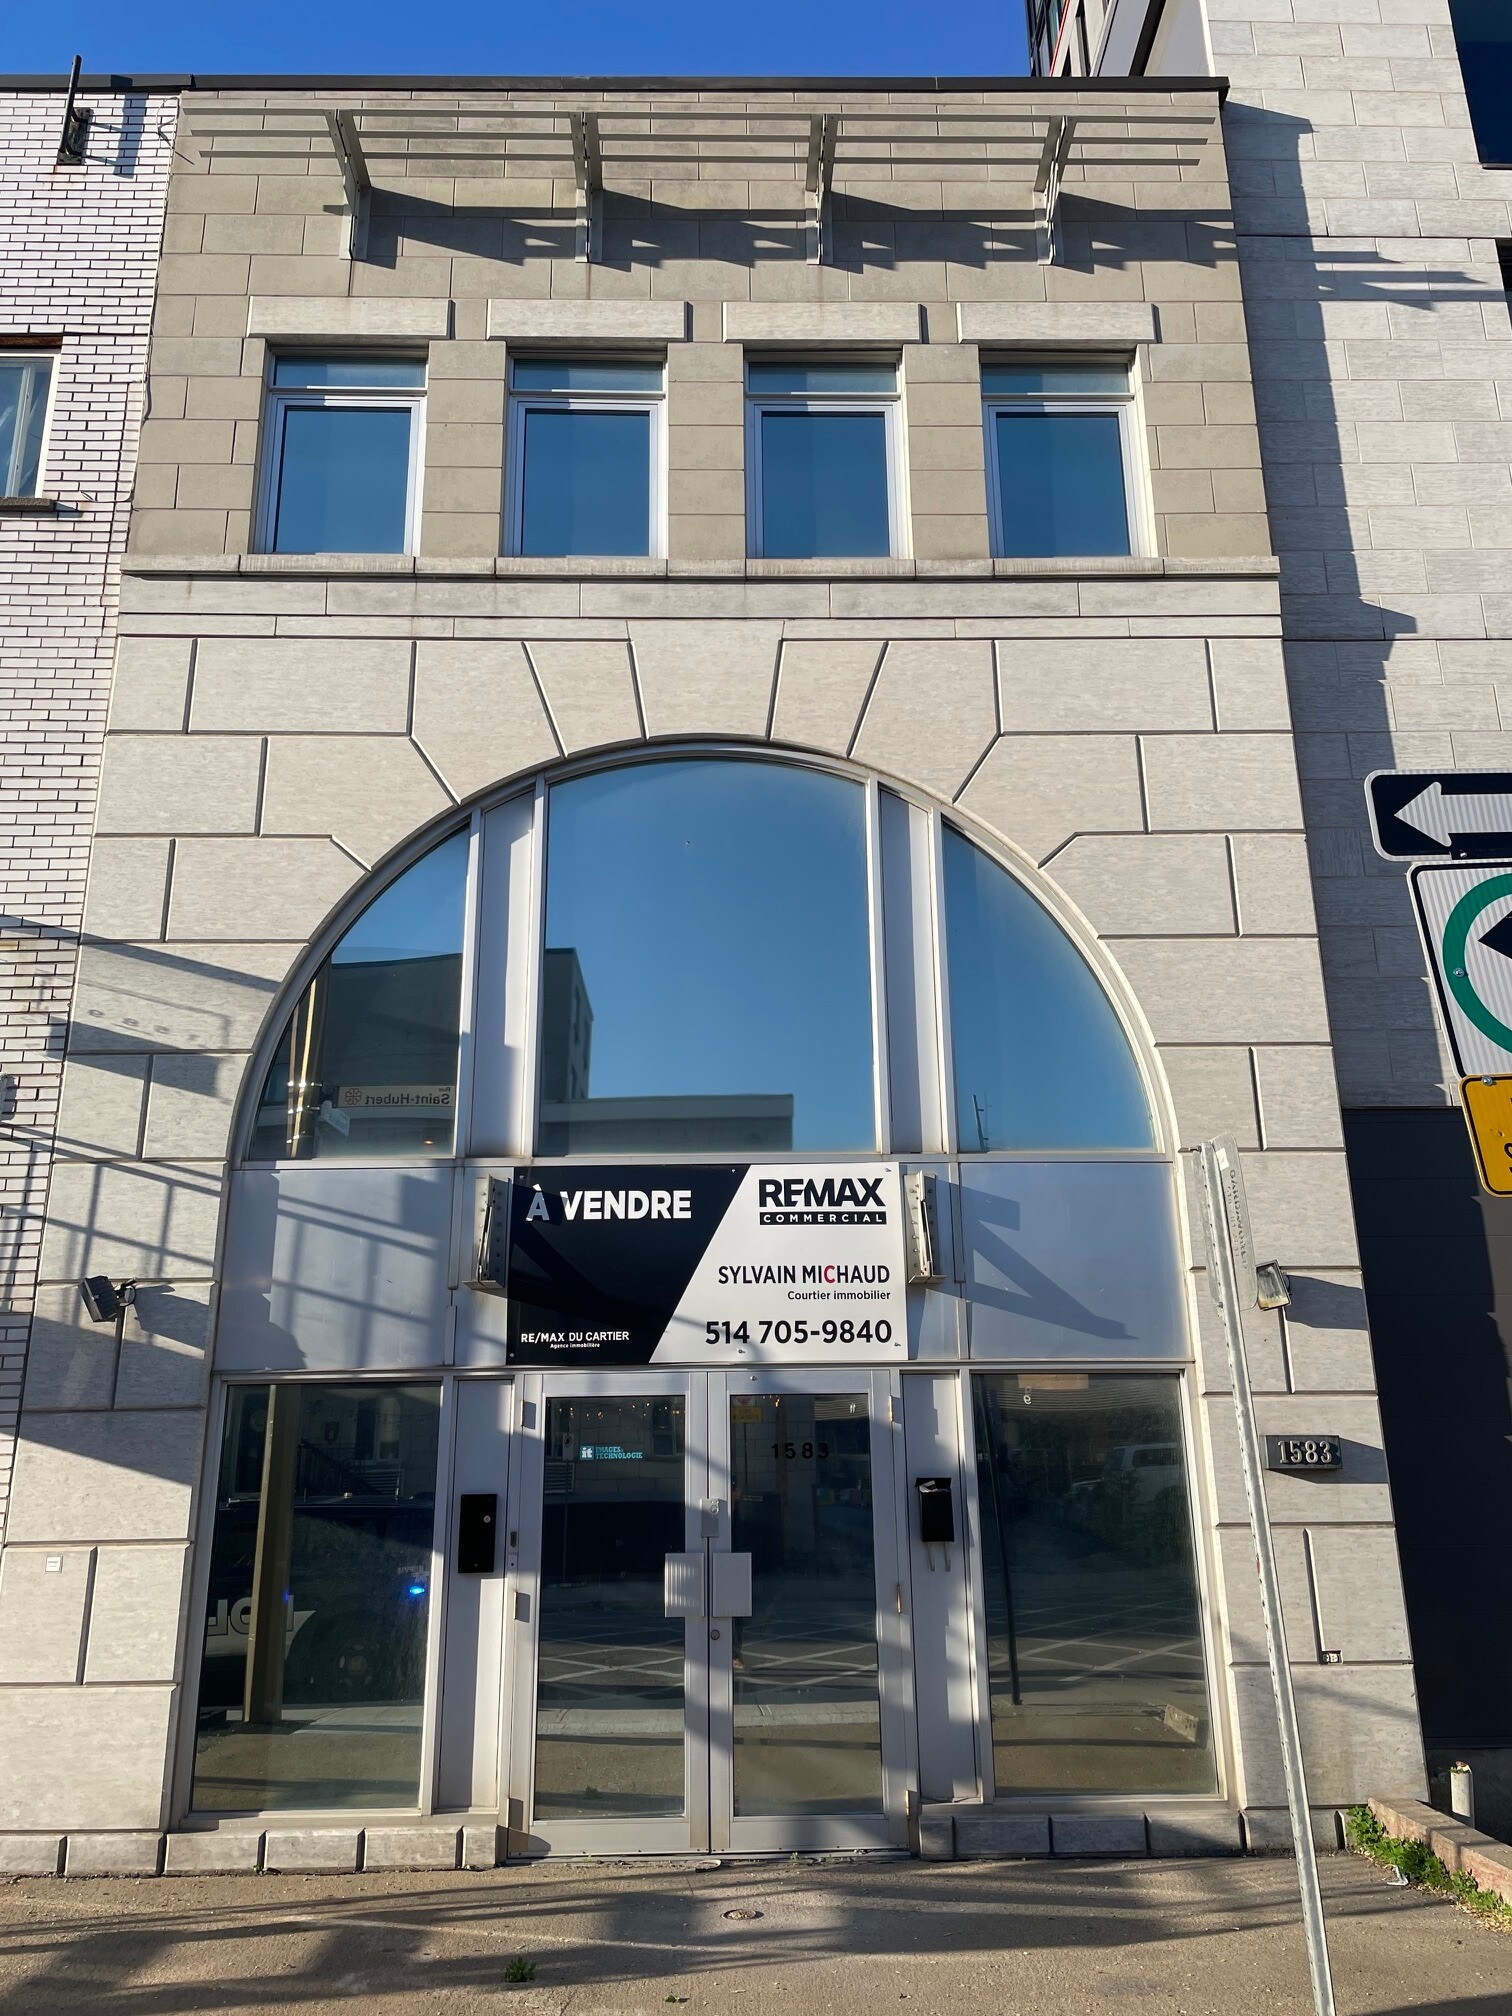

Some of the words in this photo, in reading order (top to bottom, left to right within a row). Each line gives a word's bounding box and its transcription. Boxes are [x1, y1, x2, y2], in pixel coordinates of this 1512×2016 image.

[525, 1183, 550, 1221] À
[559, 1190, 692, 1221] VENDRE
[763, 1213, 883, 1223] COMMERCIAL
[718, 1265, 796, 1284] SYLVAIN
[802, 1265, 890, 1284] MICHAUD
[788, 1290, 831, 1300] Courtier
[833, 1289, 891, 1300] immobilier
[520, 1332, 565, 1343] RE/MAX
[568, 1332, 583, 1342] DU
[585, 1331, 630, 1341] CARTIER
[705, 1320, 750, 1344] 514
[758, 1319, 892, 1344] 705-9840
[581, 1447, 593, 1458] it
[771, 1442, 830, 1460] 1583
[1277, 1440, 1333, 1464] 1583
